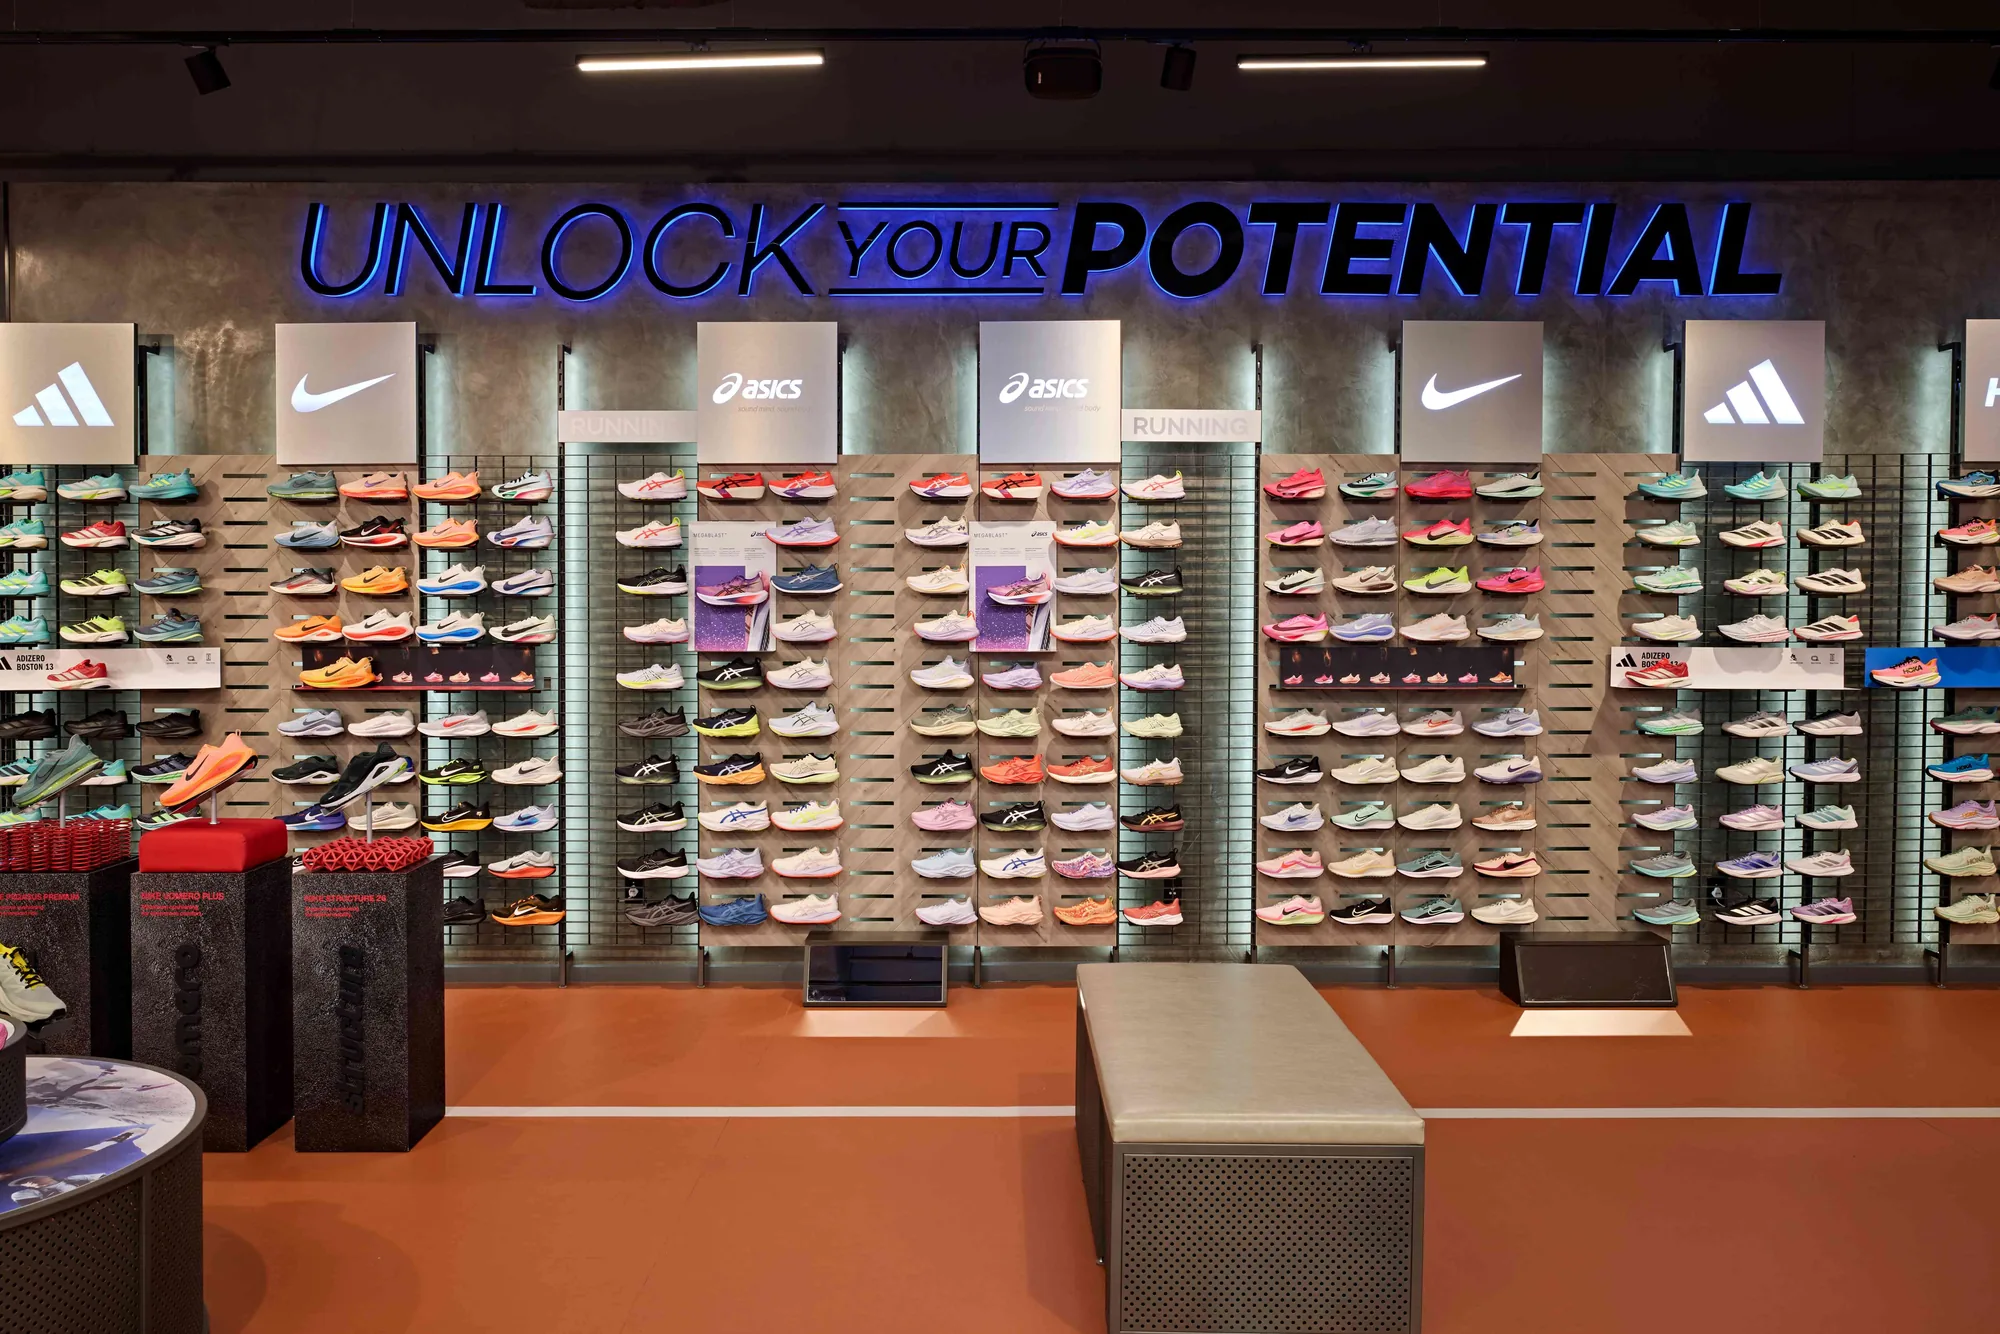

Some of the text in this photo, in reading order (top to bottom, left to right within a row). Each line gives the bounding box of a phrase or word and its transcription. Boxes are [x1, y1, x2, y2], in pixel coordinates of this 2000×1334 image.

[301, 201, 1783, 301] UNLOCK YOUR POTENTIAL
[571, 417, 684, 436] RUNNIN
[1133, 416, 1248, 436] RUNNING
[16, 654, 45, 662] ADIZERO
[16, 663, 54, 671] BOSTON 13
[1902, 664, 1923, 675] HOKA
[202, 892, 225, 900] PLUS
[175, 944, 201, 1078] omero
